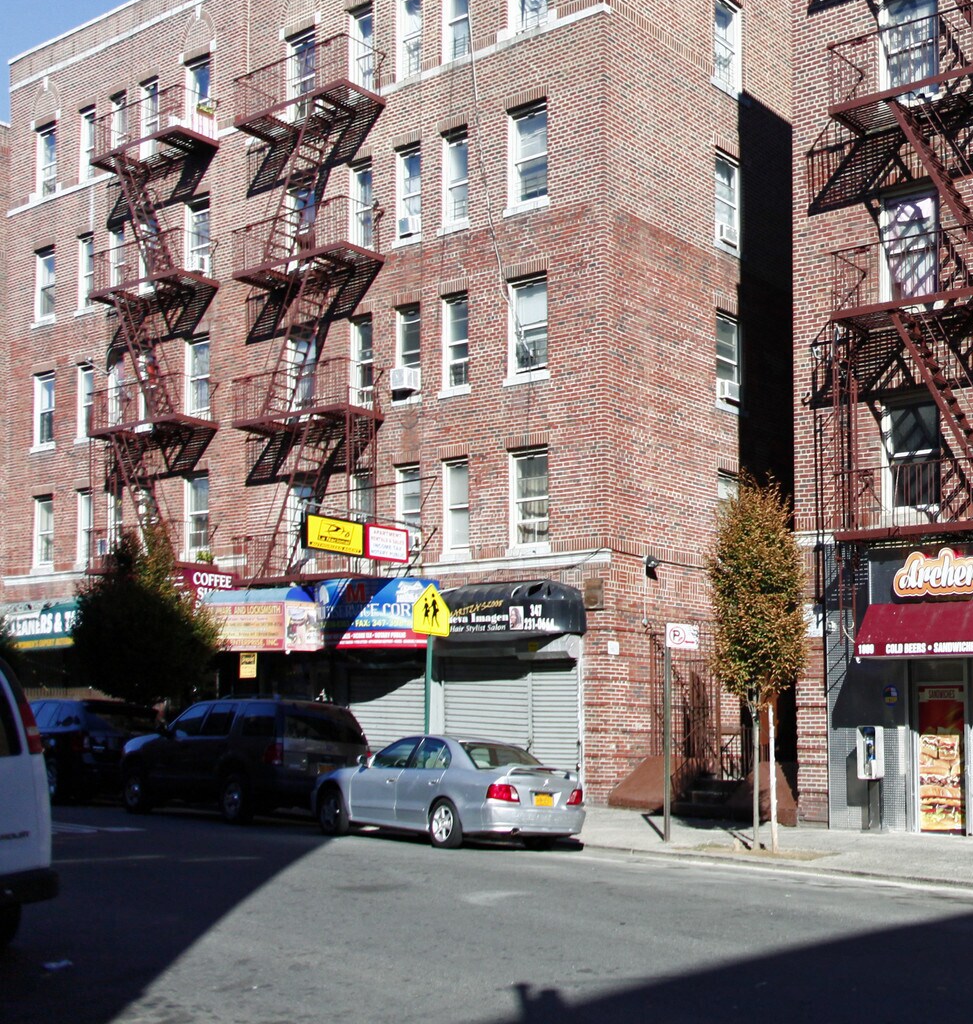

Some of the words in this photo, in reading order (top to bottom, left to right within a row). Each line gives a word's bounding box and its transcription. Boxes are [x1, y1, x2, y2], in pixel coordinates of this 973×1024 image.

[193, 572, 232, 588] COFFEE
[382, 603, 413, 617] COR
[529, 604, 542, 616] 347
[471, 613, 508, 624] Imagen
[466, 624, 486, 633] Stylist
[885, 643, 903, 654] COLD
[904, 642, 926, 654] BEERS
[928, 689, 955, 698] SANDWICHES
